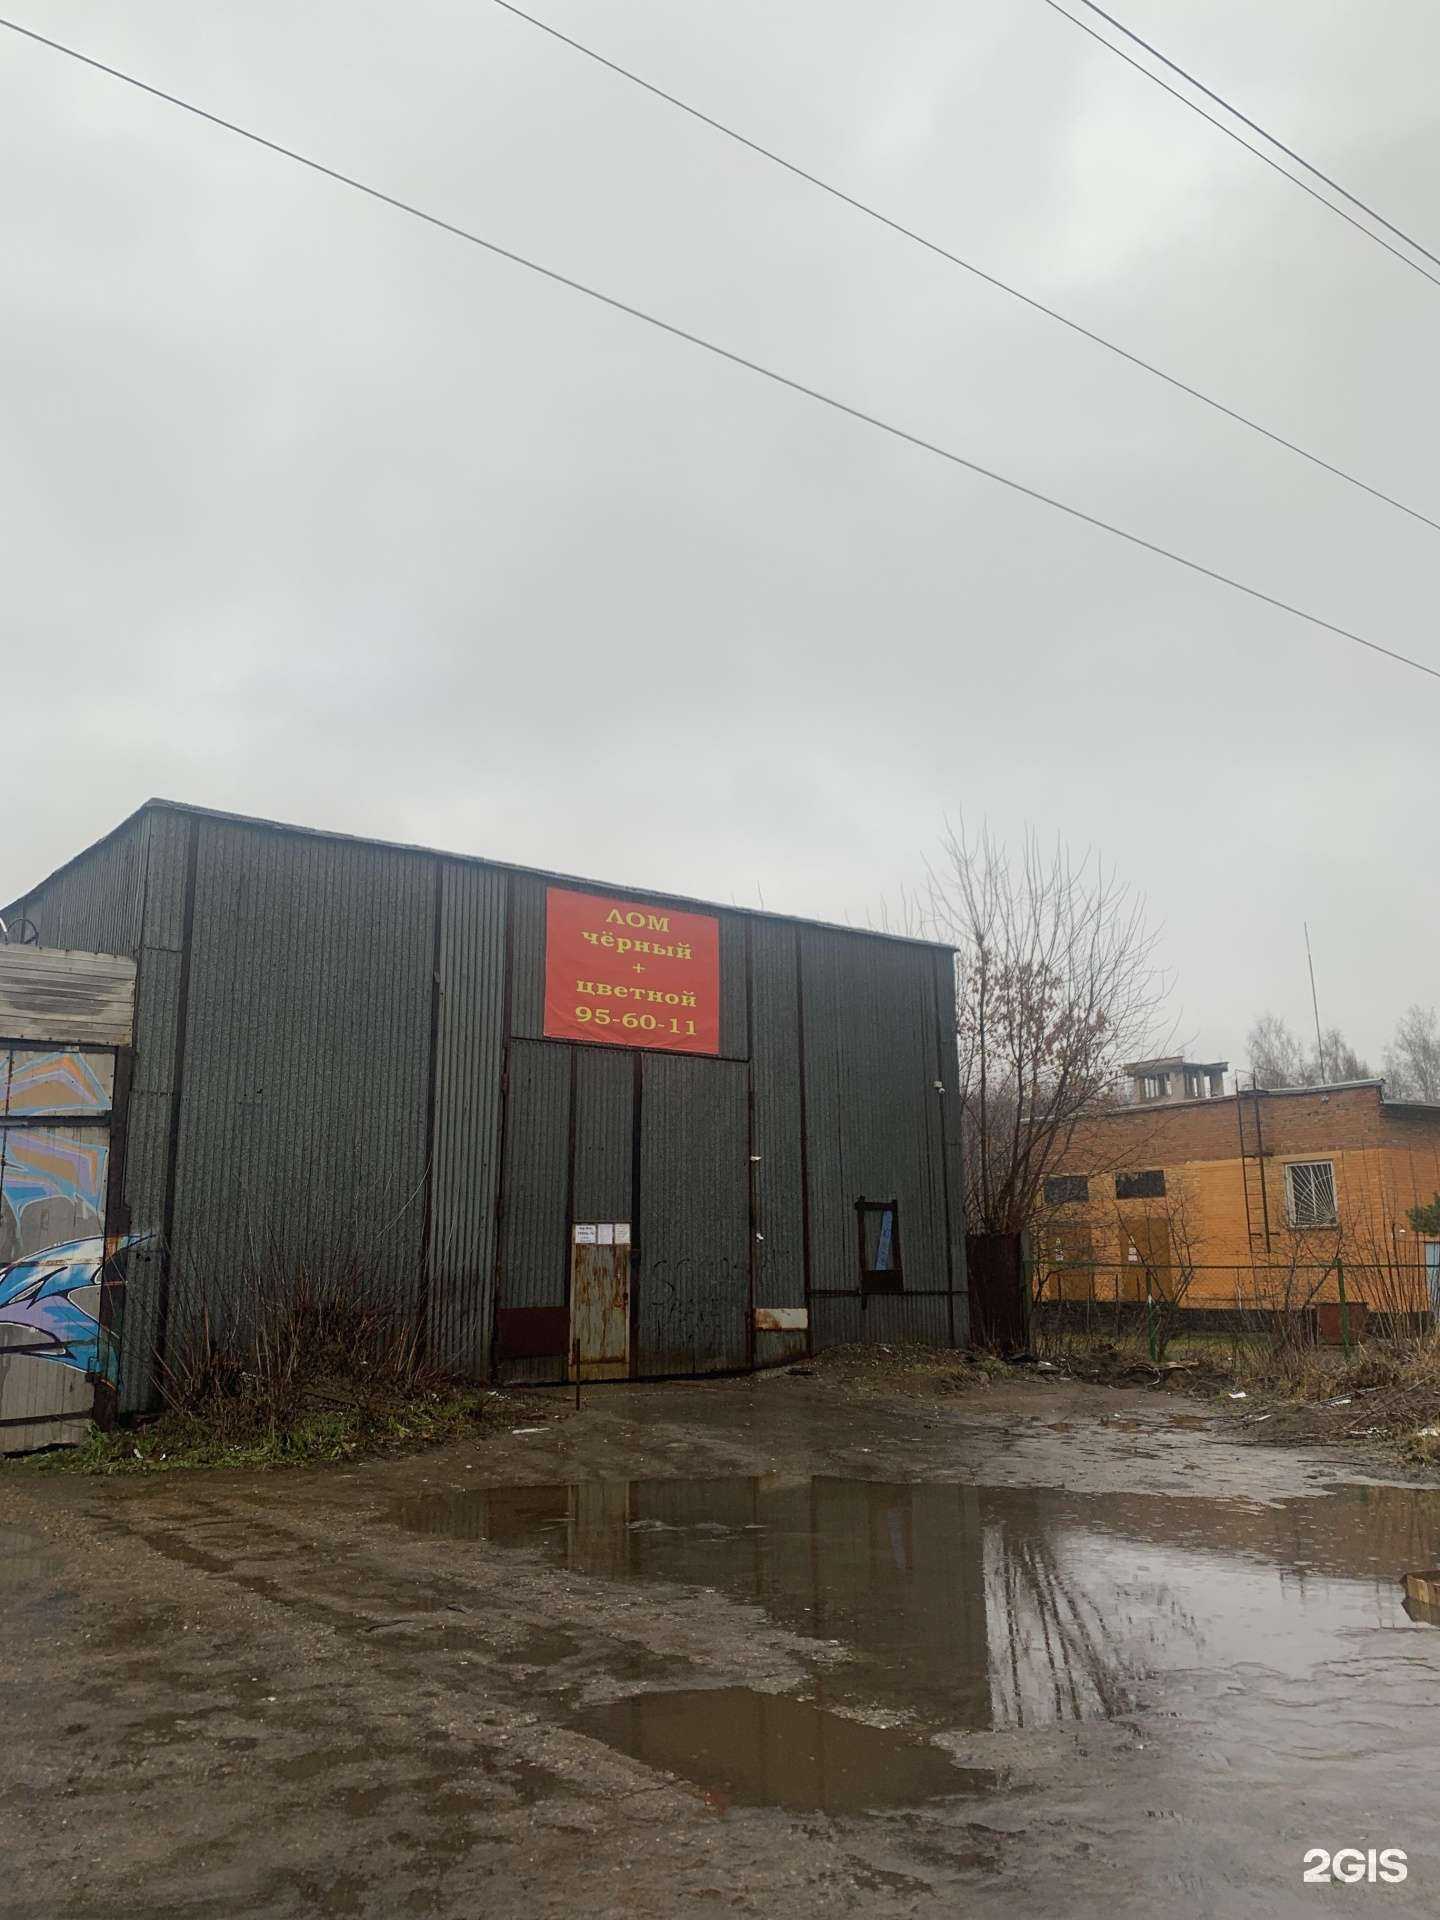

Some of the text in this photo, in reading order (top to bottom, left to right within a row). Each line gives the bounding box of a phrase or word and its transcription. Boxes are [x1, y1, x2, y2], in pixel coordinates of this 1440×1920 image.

[606, 908, 670, 933] ЛОМ
[581, 930, 694, 960] чёрный
[575, 980, 697, 1007] цветной
[575, 1006, 697, 1035] 95-60-11
